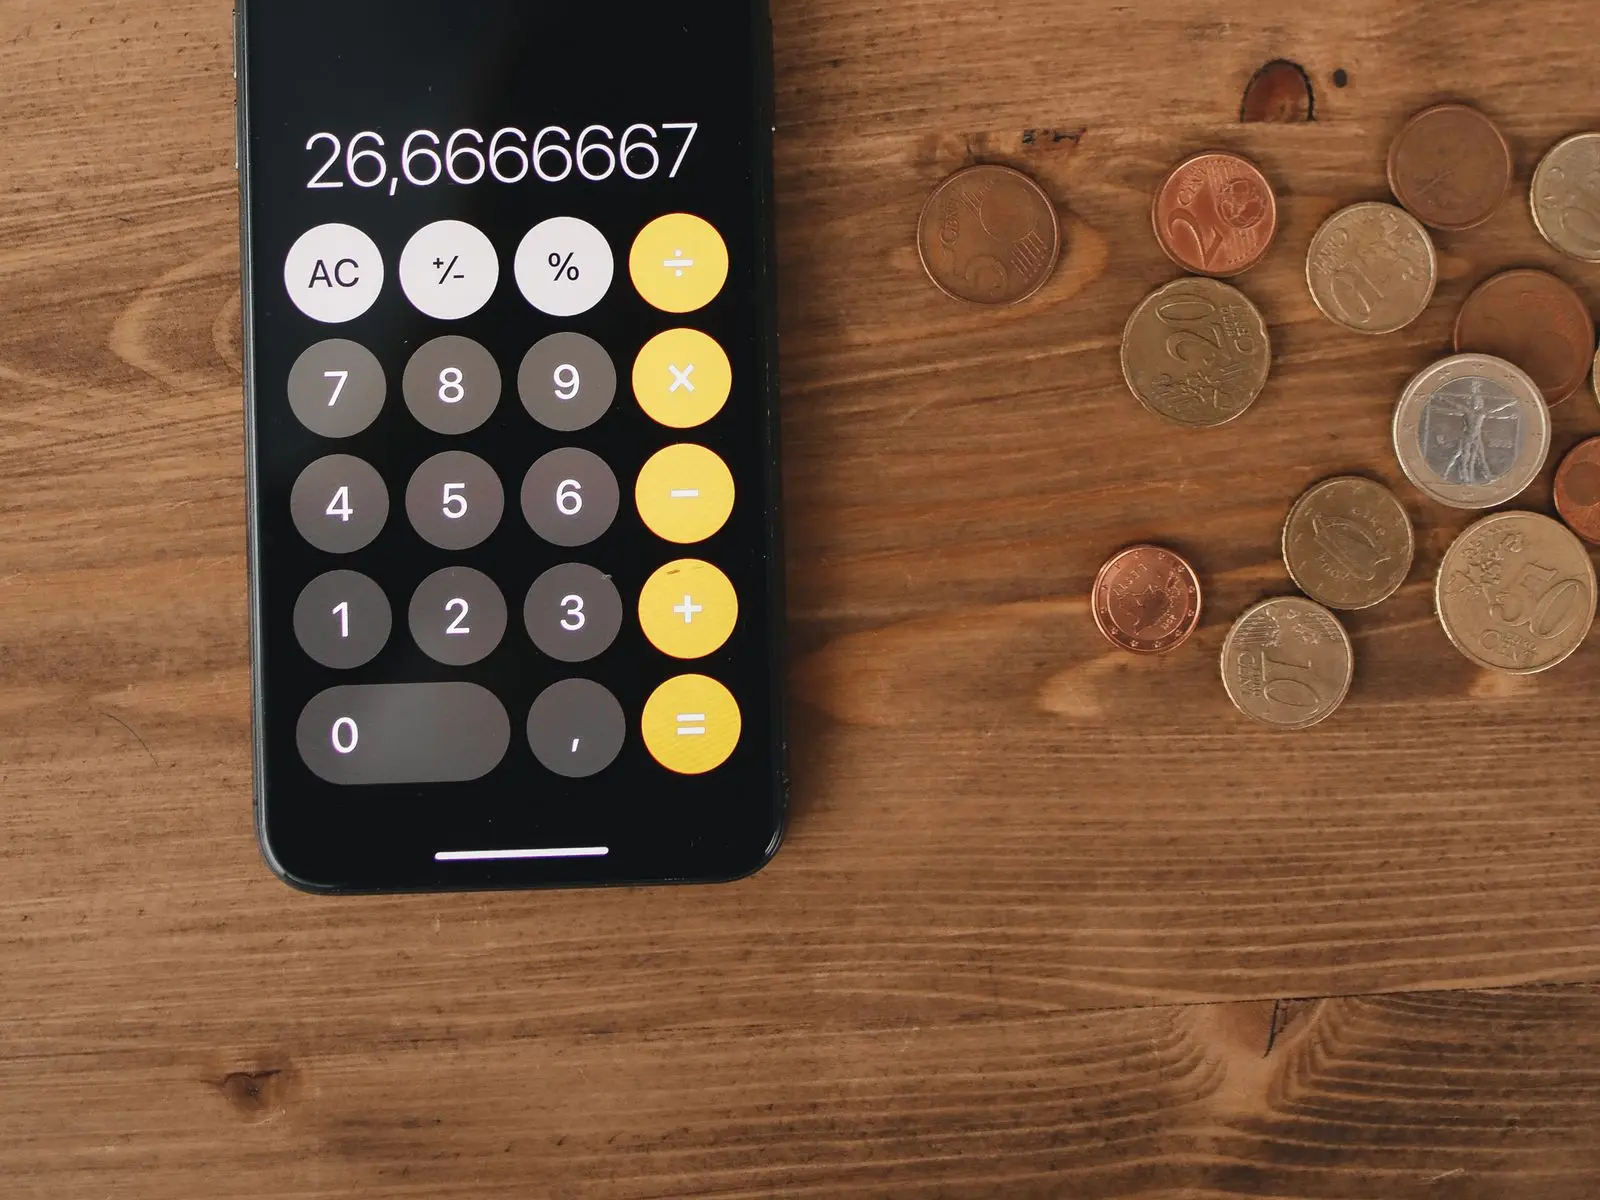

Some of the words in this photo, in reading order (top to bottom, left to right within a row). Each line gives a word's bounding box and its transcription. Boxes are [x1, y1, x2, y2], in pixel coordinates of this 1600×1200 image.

[305, 122, 698, 197] 26,6666667
[1166, 207, 1224, 269] 2
[309, 259, 359, 288] AC
[549, 252, 579, 281] %
[1155, 293, 1233, 364] 20
[323, 370, 349, 407] 7
[438, 367, 465, 403] 8
[553, 363, 580, 400] 9
[325, 486, 354, 522] 4
[442, 482, 468, 519] 5
[556, 479, 583, 516] 6
[332, 601, 349, 638] 1
[445, 597, 470, 634] 2
[560, 594, 586, 631] 3
[1489, 562, 1592, 640] 50
[331, 716, 359, 754] 0
